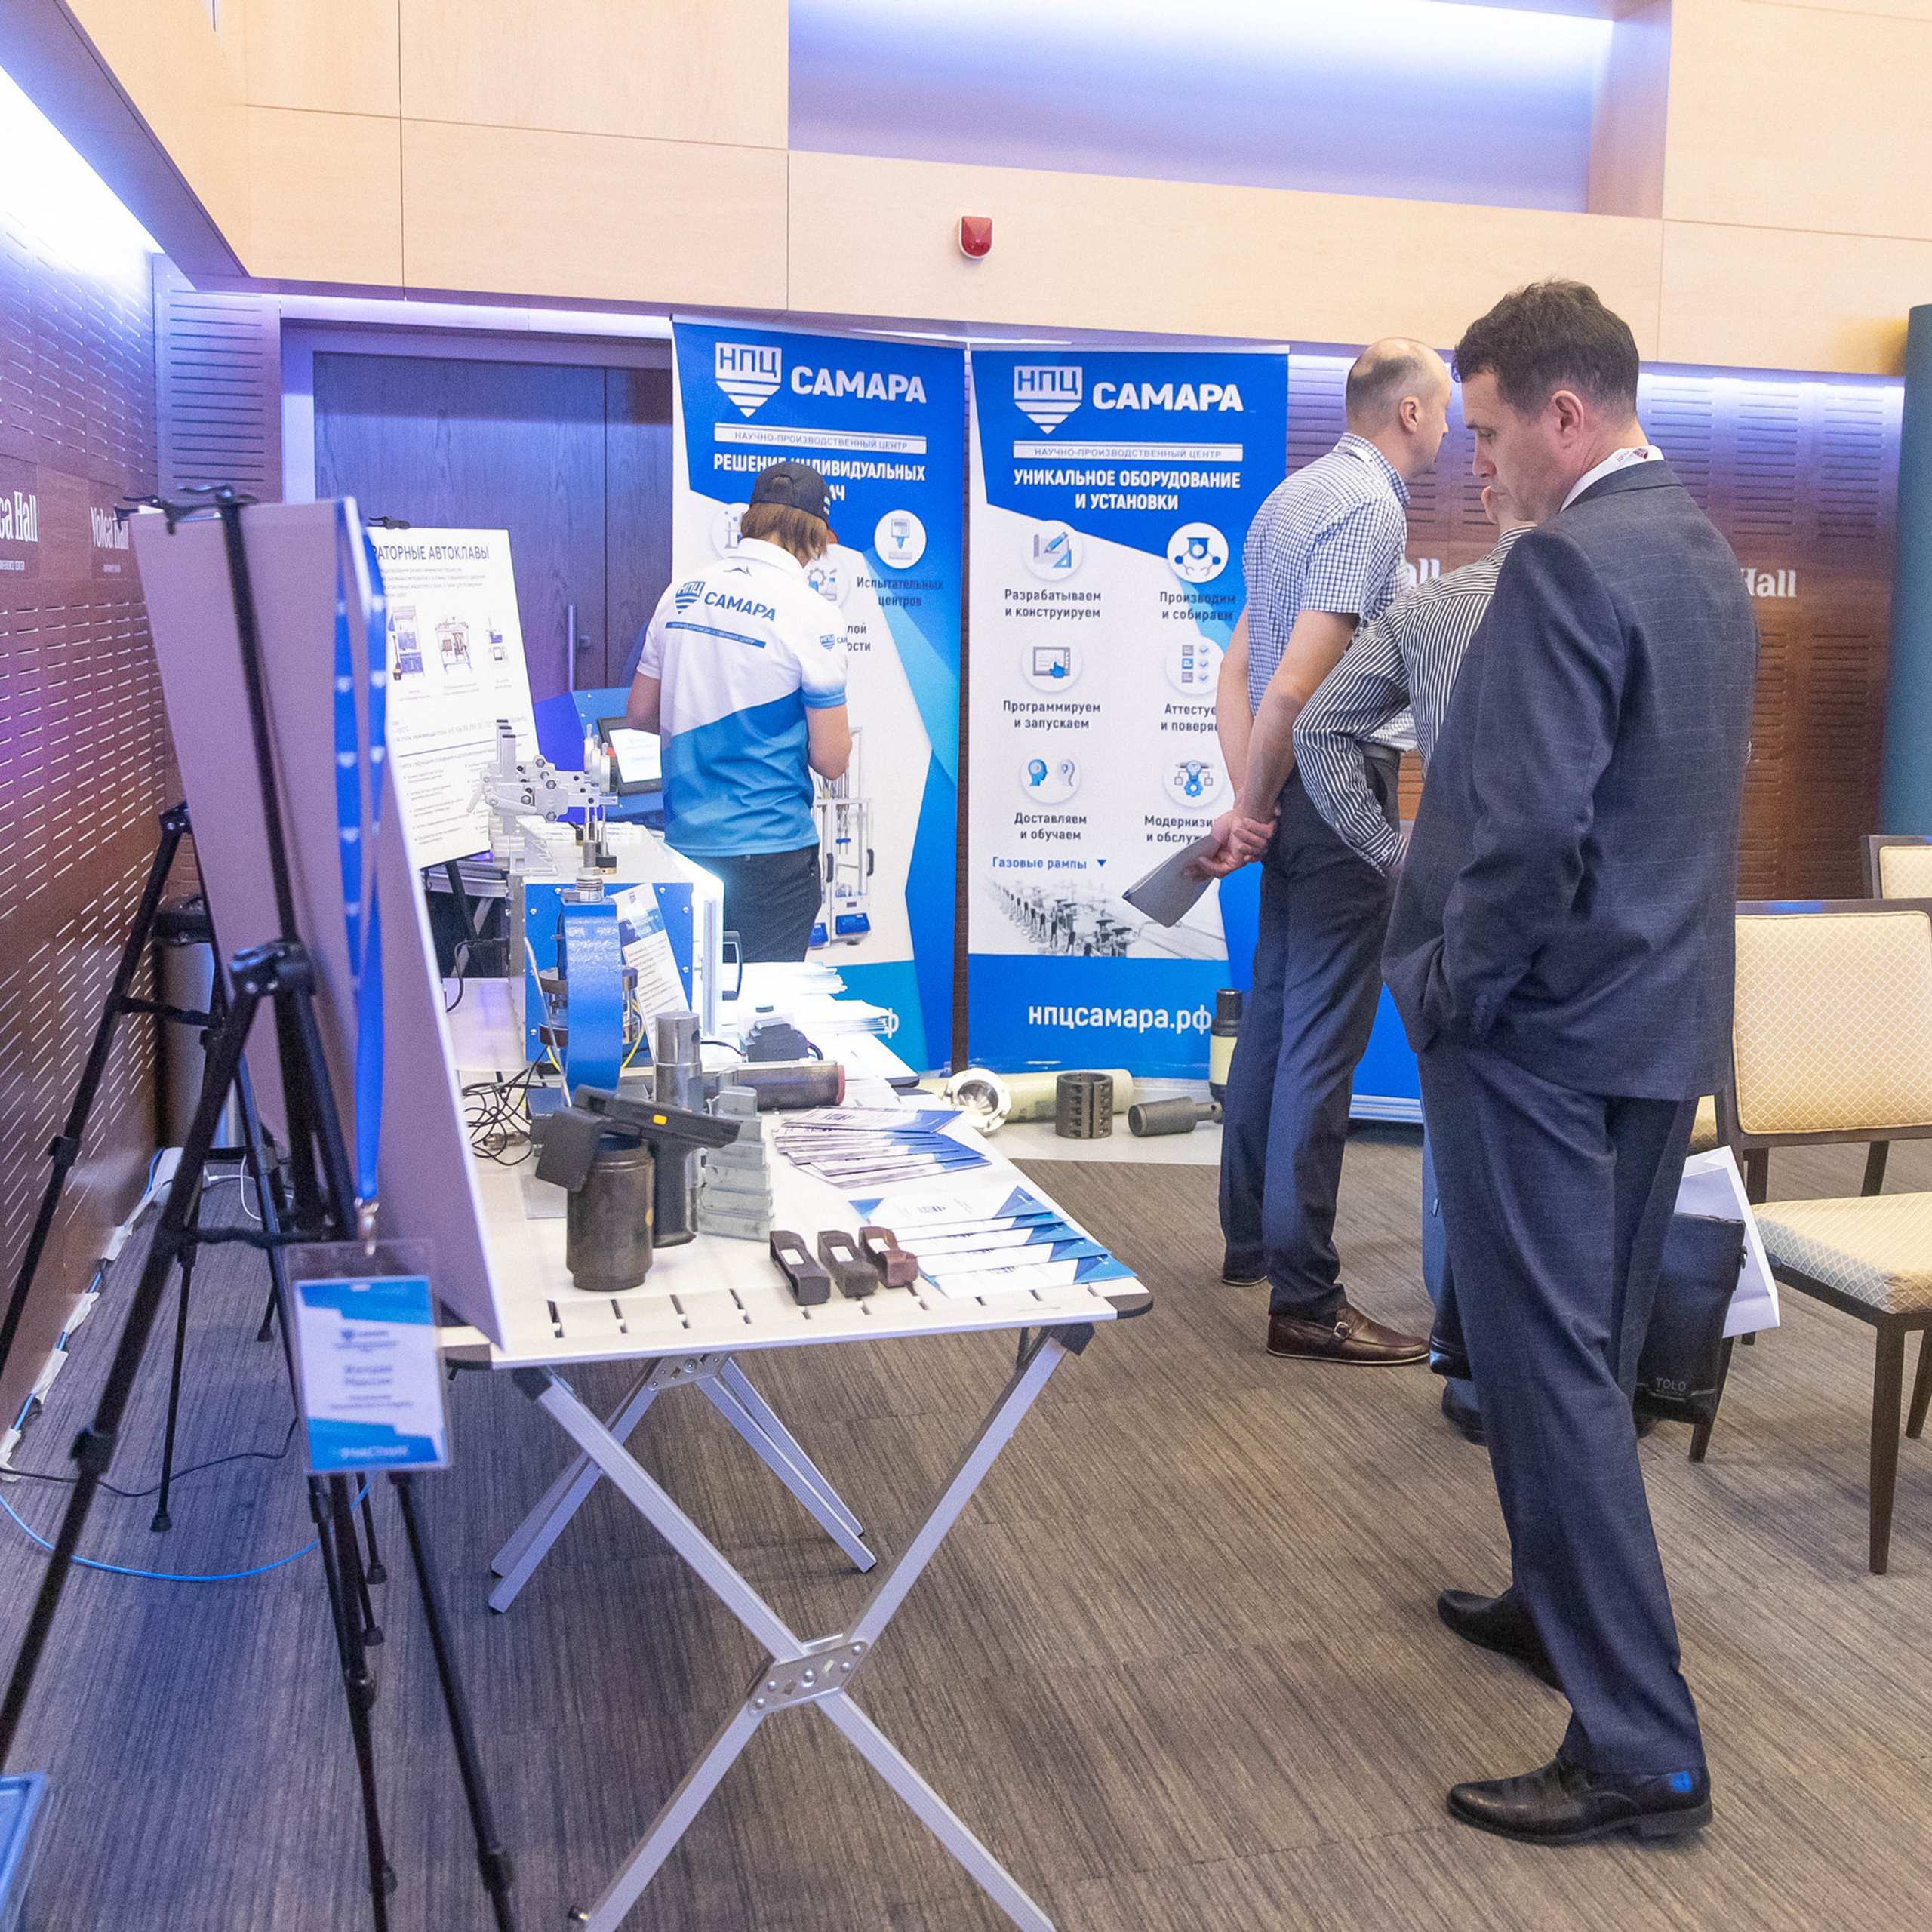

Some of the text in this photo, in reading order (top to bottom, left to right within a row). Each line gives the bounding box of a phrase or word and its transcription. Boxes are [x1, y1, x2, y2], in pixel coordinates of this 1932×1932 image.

[719, 348, 777, 380] НПЦ
[791, 366, 927, 403] САМАРА
[1018, 371, 1078, 395] НПЦ
[1093, 382, 1244, 411] САМАРА
[734, 431, 908, 451] НАУЧНО-ПРОИЗВОДСТВЕННЫЙ ЦЕНТР
[1035, 448, 1221, 460] НАУЧНО-ПРОИЗВОДСТВЕННЫЙ ЦЕНТР
[794, 457, 925, 481] ДИВИДУАЛЬНЫХ
[1014, 470, 1241, 489] УНИКАЛЬНОЕ ОБОРУДОВАНИЕ
[1075, 494, 1178, 510] И УСТАНОВКИ
[14, 491, 38, 542] Hall
[429, 546, 489, 560] АВТОКЛАВЫ
[857, 576, 943, 591] Испытательных
[878, 595, 922, 608] центров
[1004, 589, 1101, 602] Разрабатываем
[1160, 592, 1235, 605] Производим
[704, 592, 776, 621] САМАРА
[1005, 608, 1100, 620] и конструируем
[1163, 608, 1232, 623] и собираем
[1003, 700, 1100, 716] Программируем
[1014, 719, 1089, 731] и запускаем
[1161, 721, 1168, 731] и
[1014, 812, 1087, 826] Доставляем
[1020, 828, 1081, 842] и обучаем
[1146, 833, 1152, 841] и
[992, 857, 1087, 871] Газовые рампы
[1029, 1004, 1213, 1036] нпцсамара.рф
